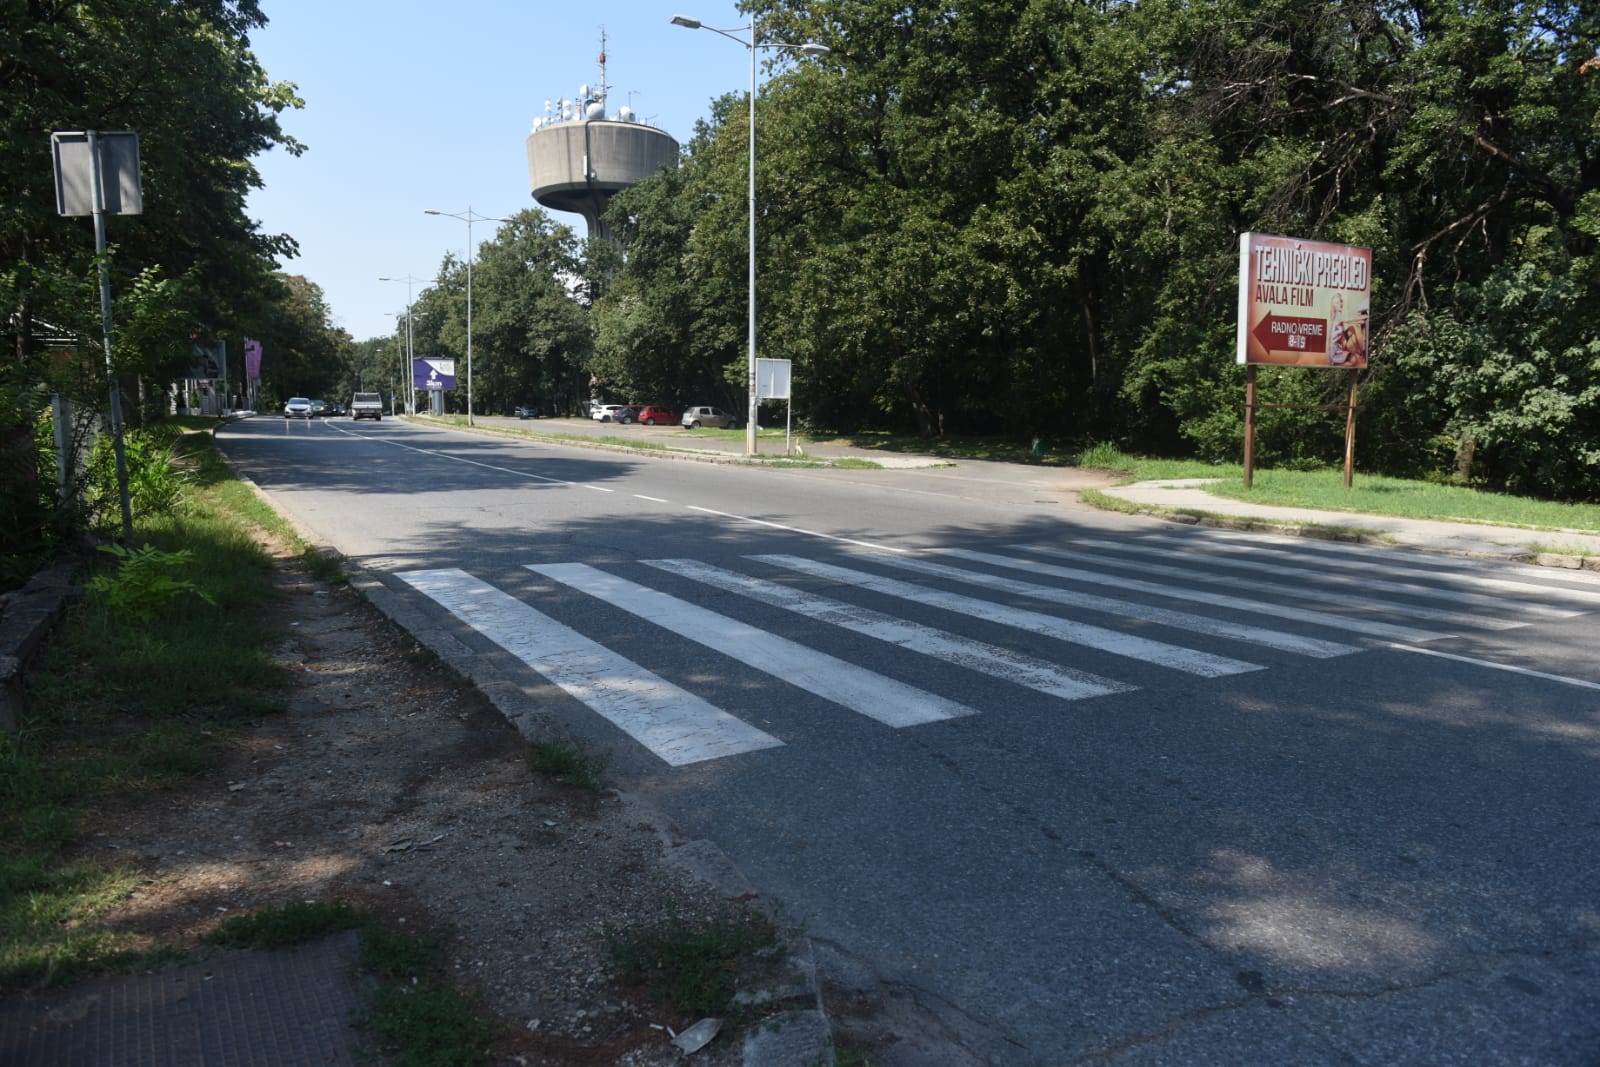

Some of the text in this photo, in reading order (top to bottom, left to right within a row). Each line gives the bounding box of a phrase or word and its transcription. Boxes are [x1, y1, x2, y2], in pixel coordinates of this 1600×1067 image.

[1255, 241, 1367, 291] TEHNIČKI PREGLED
[1255, 284, 1314, 307] AVALA FILM
[1271, 321, 1323, 336] RADNO VREME
